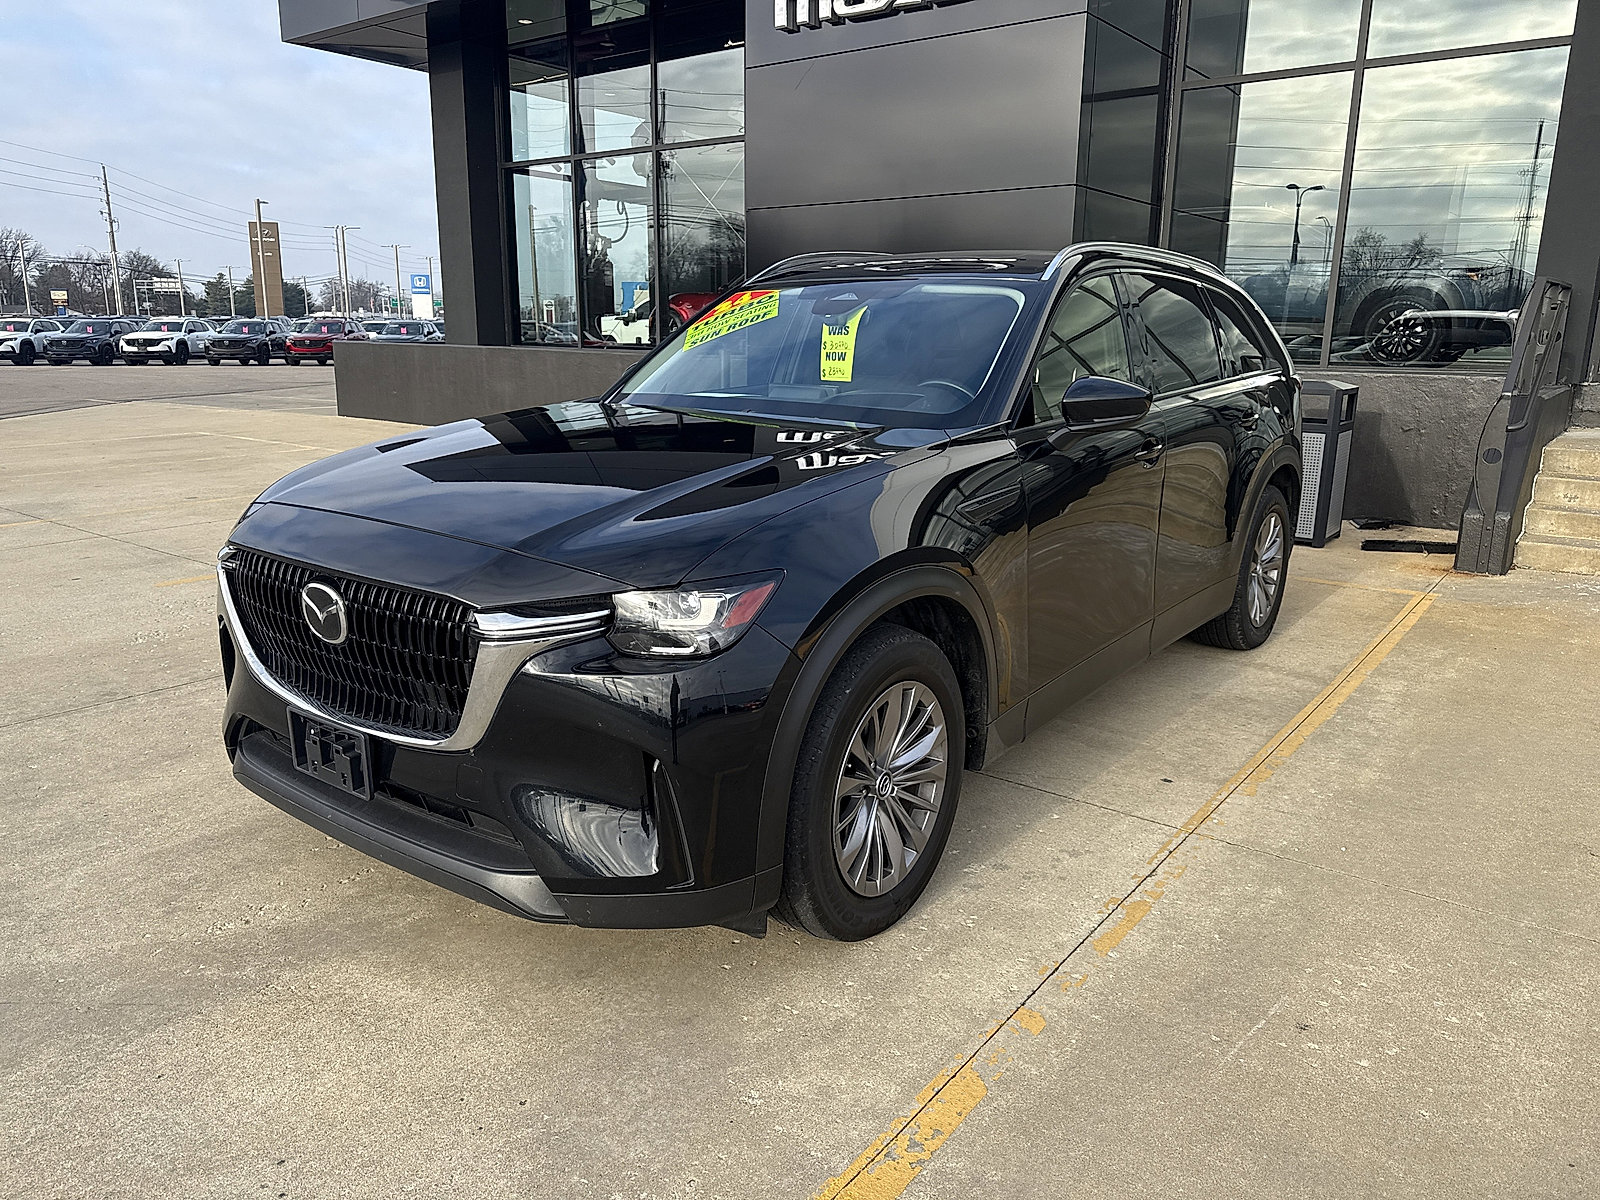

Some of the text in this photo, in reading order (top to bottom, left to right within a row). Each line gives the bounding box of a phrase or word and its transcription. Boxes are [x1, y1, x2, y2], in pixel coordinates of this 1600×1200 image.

[688, 309, 774, 348] SUN ROOF
[690, 294, 777, 332] TURBO
[706, 318, 731, 332] ROW
[732, 301, 777, 322] SEATING
[828, 325, 850, 336] WAS
[825, 351, 847, 362] NOW
